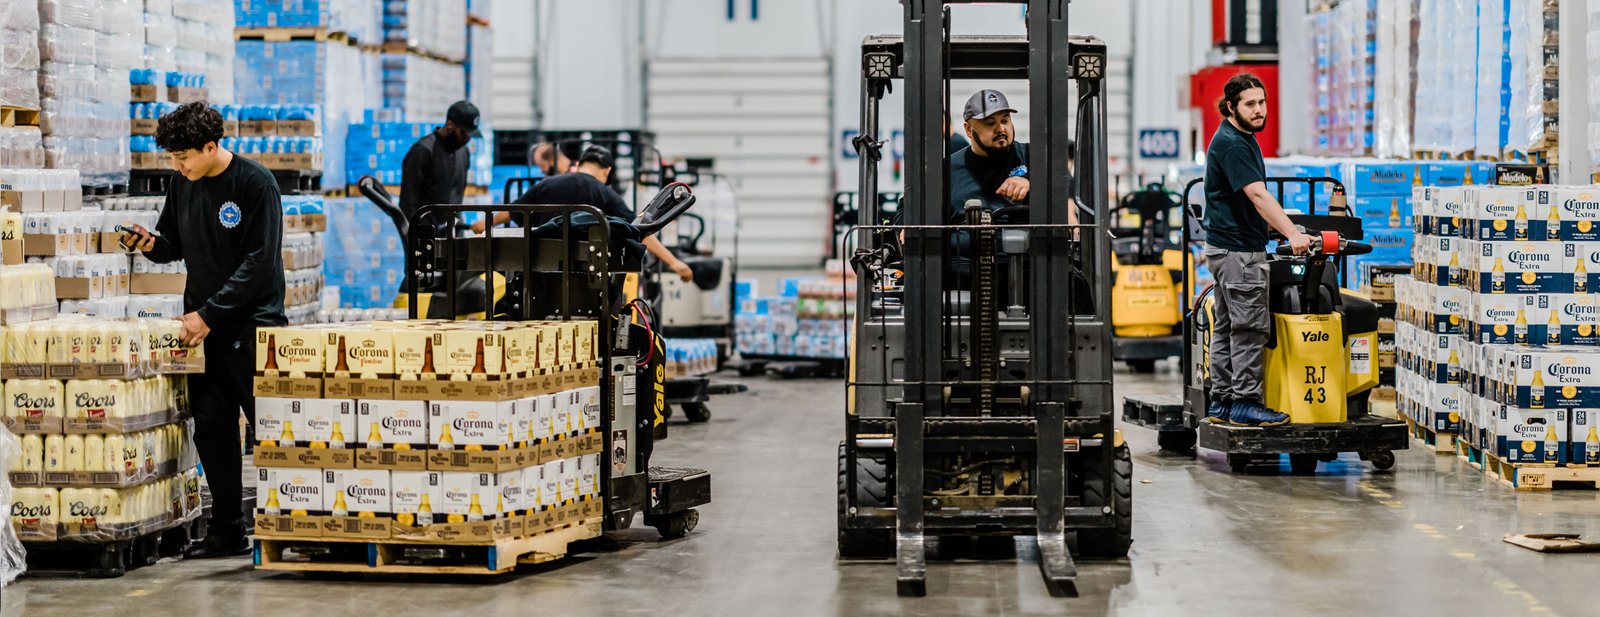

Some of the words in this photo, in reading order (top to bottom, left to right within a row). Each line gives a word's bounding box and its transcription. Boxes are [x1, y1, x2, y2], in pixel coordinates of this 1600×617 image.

[1373, 170, 1404, 180] Modelo
[1500, 172, 1530, 182] Modelo
[1486, 204, 1514, 213] Corona
[1564, 198, 1600, 211] Coron
[1575, 210, 1596, 218] Extra
[1372, 234, 1404, 244] Modelo
[1508, 250, 1550, 264] Corona
[1486, 308, 1515, 318] Corona
[1564, 302, 1596, 315] Coro
[1302, 331, 1330, 342] Yale
[278, 345, 316, 358] Corona
[349, 347, 389, 360] Corona
[289, 356, 310, 365] Familiar
[360, 358, 382, 367] Familiar
[1304, 366, 1326, 384] RJ
[1548, 362, 1591, 376] Corona
[1559, 375, 1580, 383] Extra
[14, 392, 56, 408] Coors
[74, 392, 116, 408] Coors
[654, 363, 664, 428] Yale
[1304, 388, 1326, 404] 43
[584, 403, 600, 416] Corona
[259, 418, 280, 427] Corona
[308, 420, 329, 428] Corona
[382, 416, 422, 429] Corona
[453, 417, 494, 432] Corona
[392, 428, 412, 436] Extra
[464, 430, 484, 438] Extra
[1514, 424, 1544, 434] Corona
[280, 482, 319, 496] Corona
[347, 484, 386, 498] Corona
[290, 494, 310, 502] Extra
[358, 496, 377, 504] Extra
[10, 501, 51, 516] Coors
